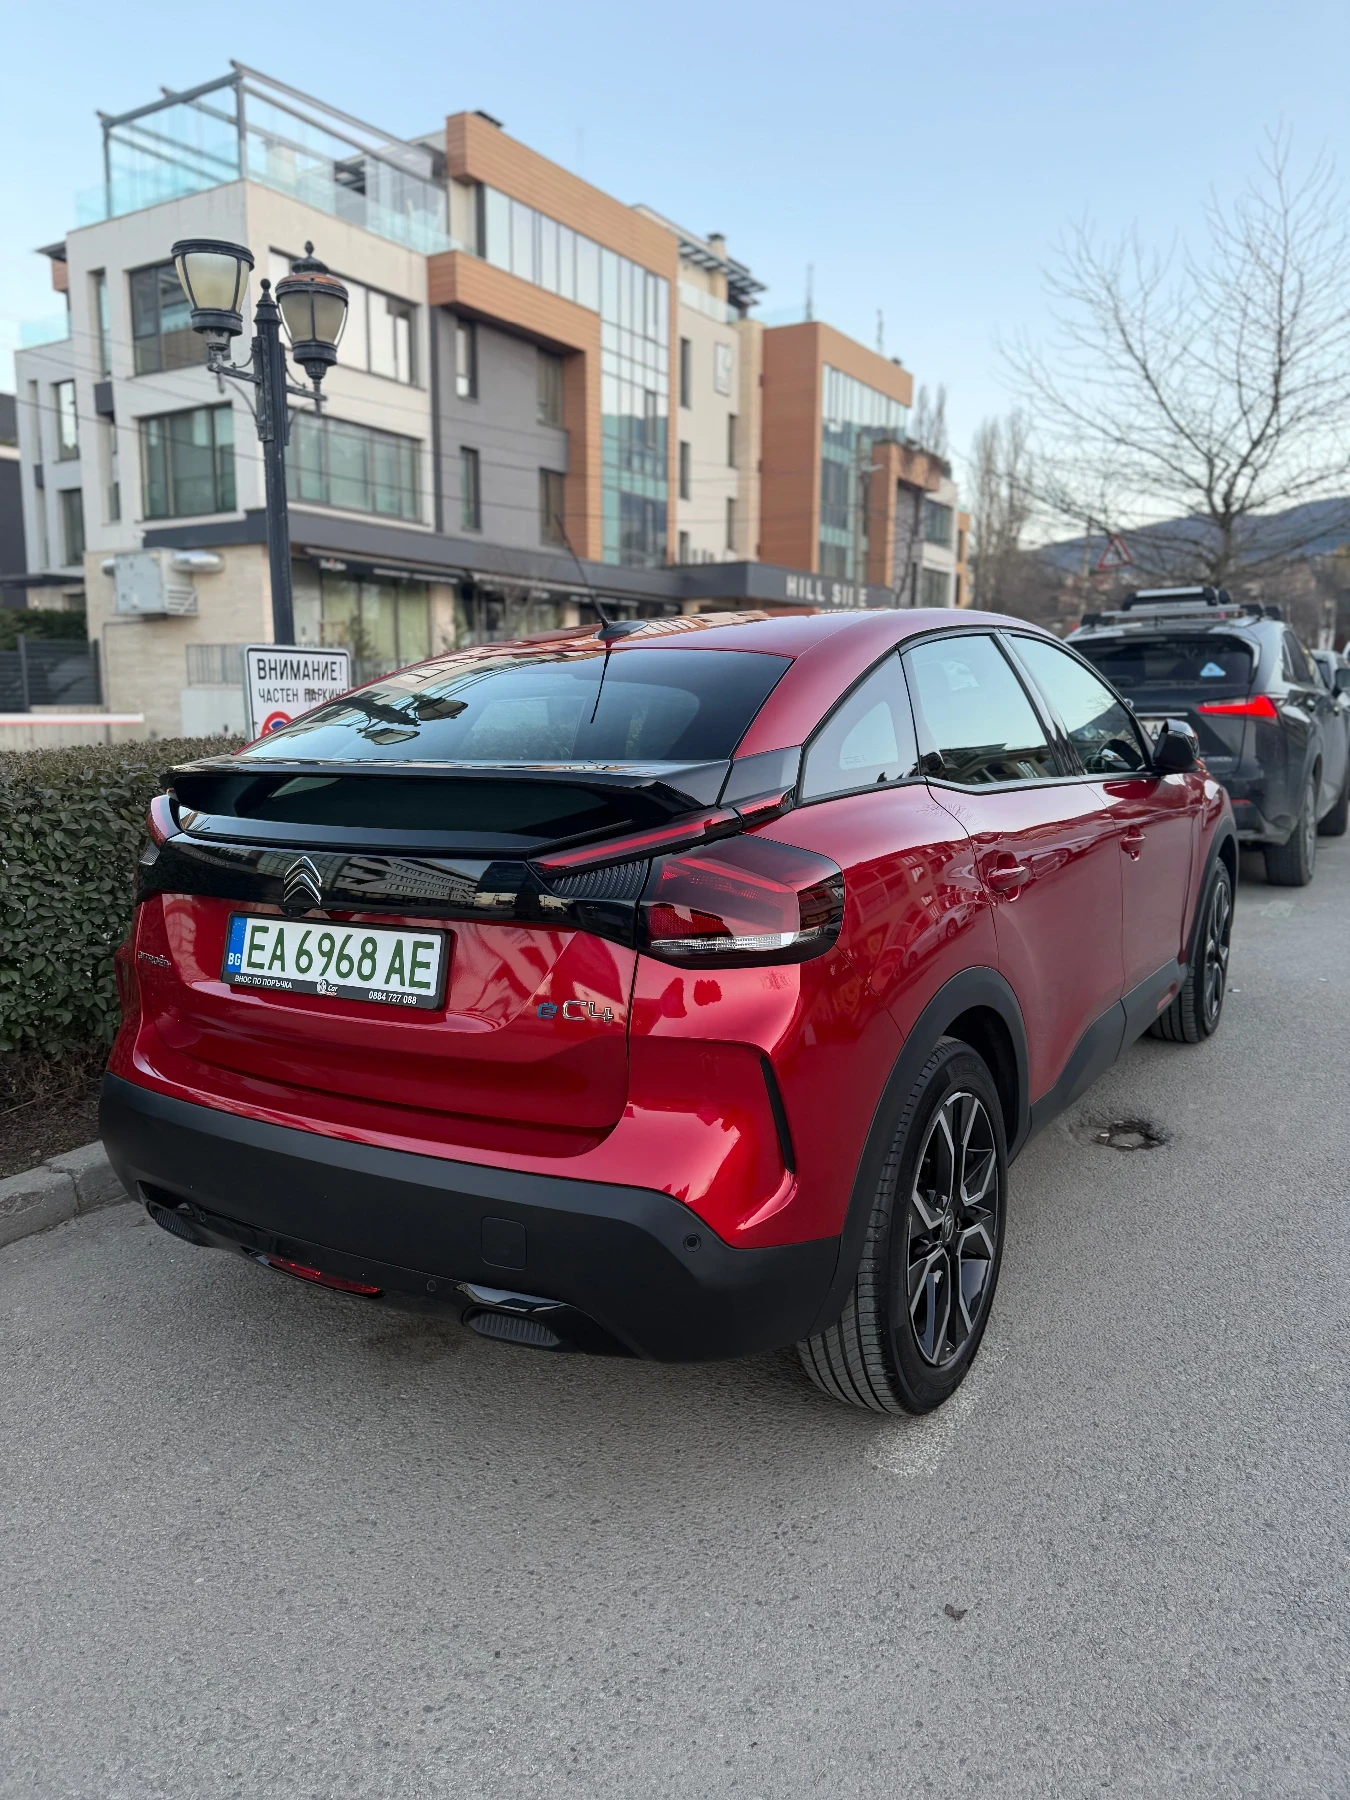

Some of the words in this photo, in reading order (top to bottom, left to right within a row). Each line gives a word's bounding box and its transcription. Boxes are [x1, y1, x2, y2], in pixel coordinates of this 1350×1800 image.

[257, 658, 342, 681] ВНИМАНИЕ!
[258, 688, 299, 703] ЧАСТЕН
[227, 952, 241, 966] BG
[247, 925, 285, 972] EA
[295, 930, 378, 981] 6968
[384, 939, 435, 989] AE
[235, 975, 251, 983] ВНОС
[252, 977, 262, 985] ПО
[262, 978, 293, 989] ПОРЪЧКА
[388, 993, 402, 1003] 727
